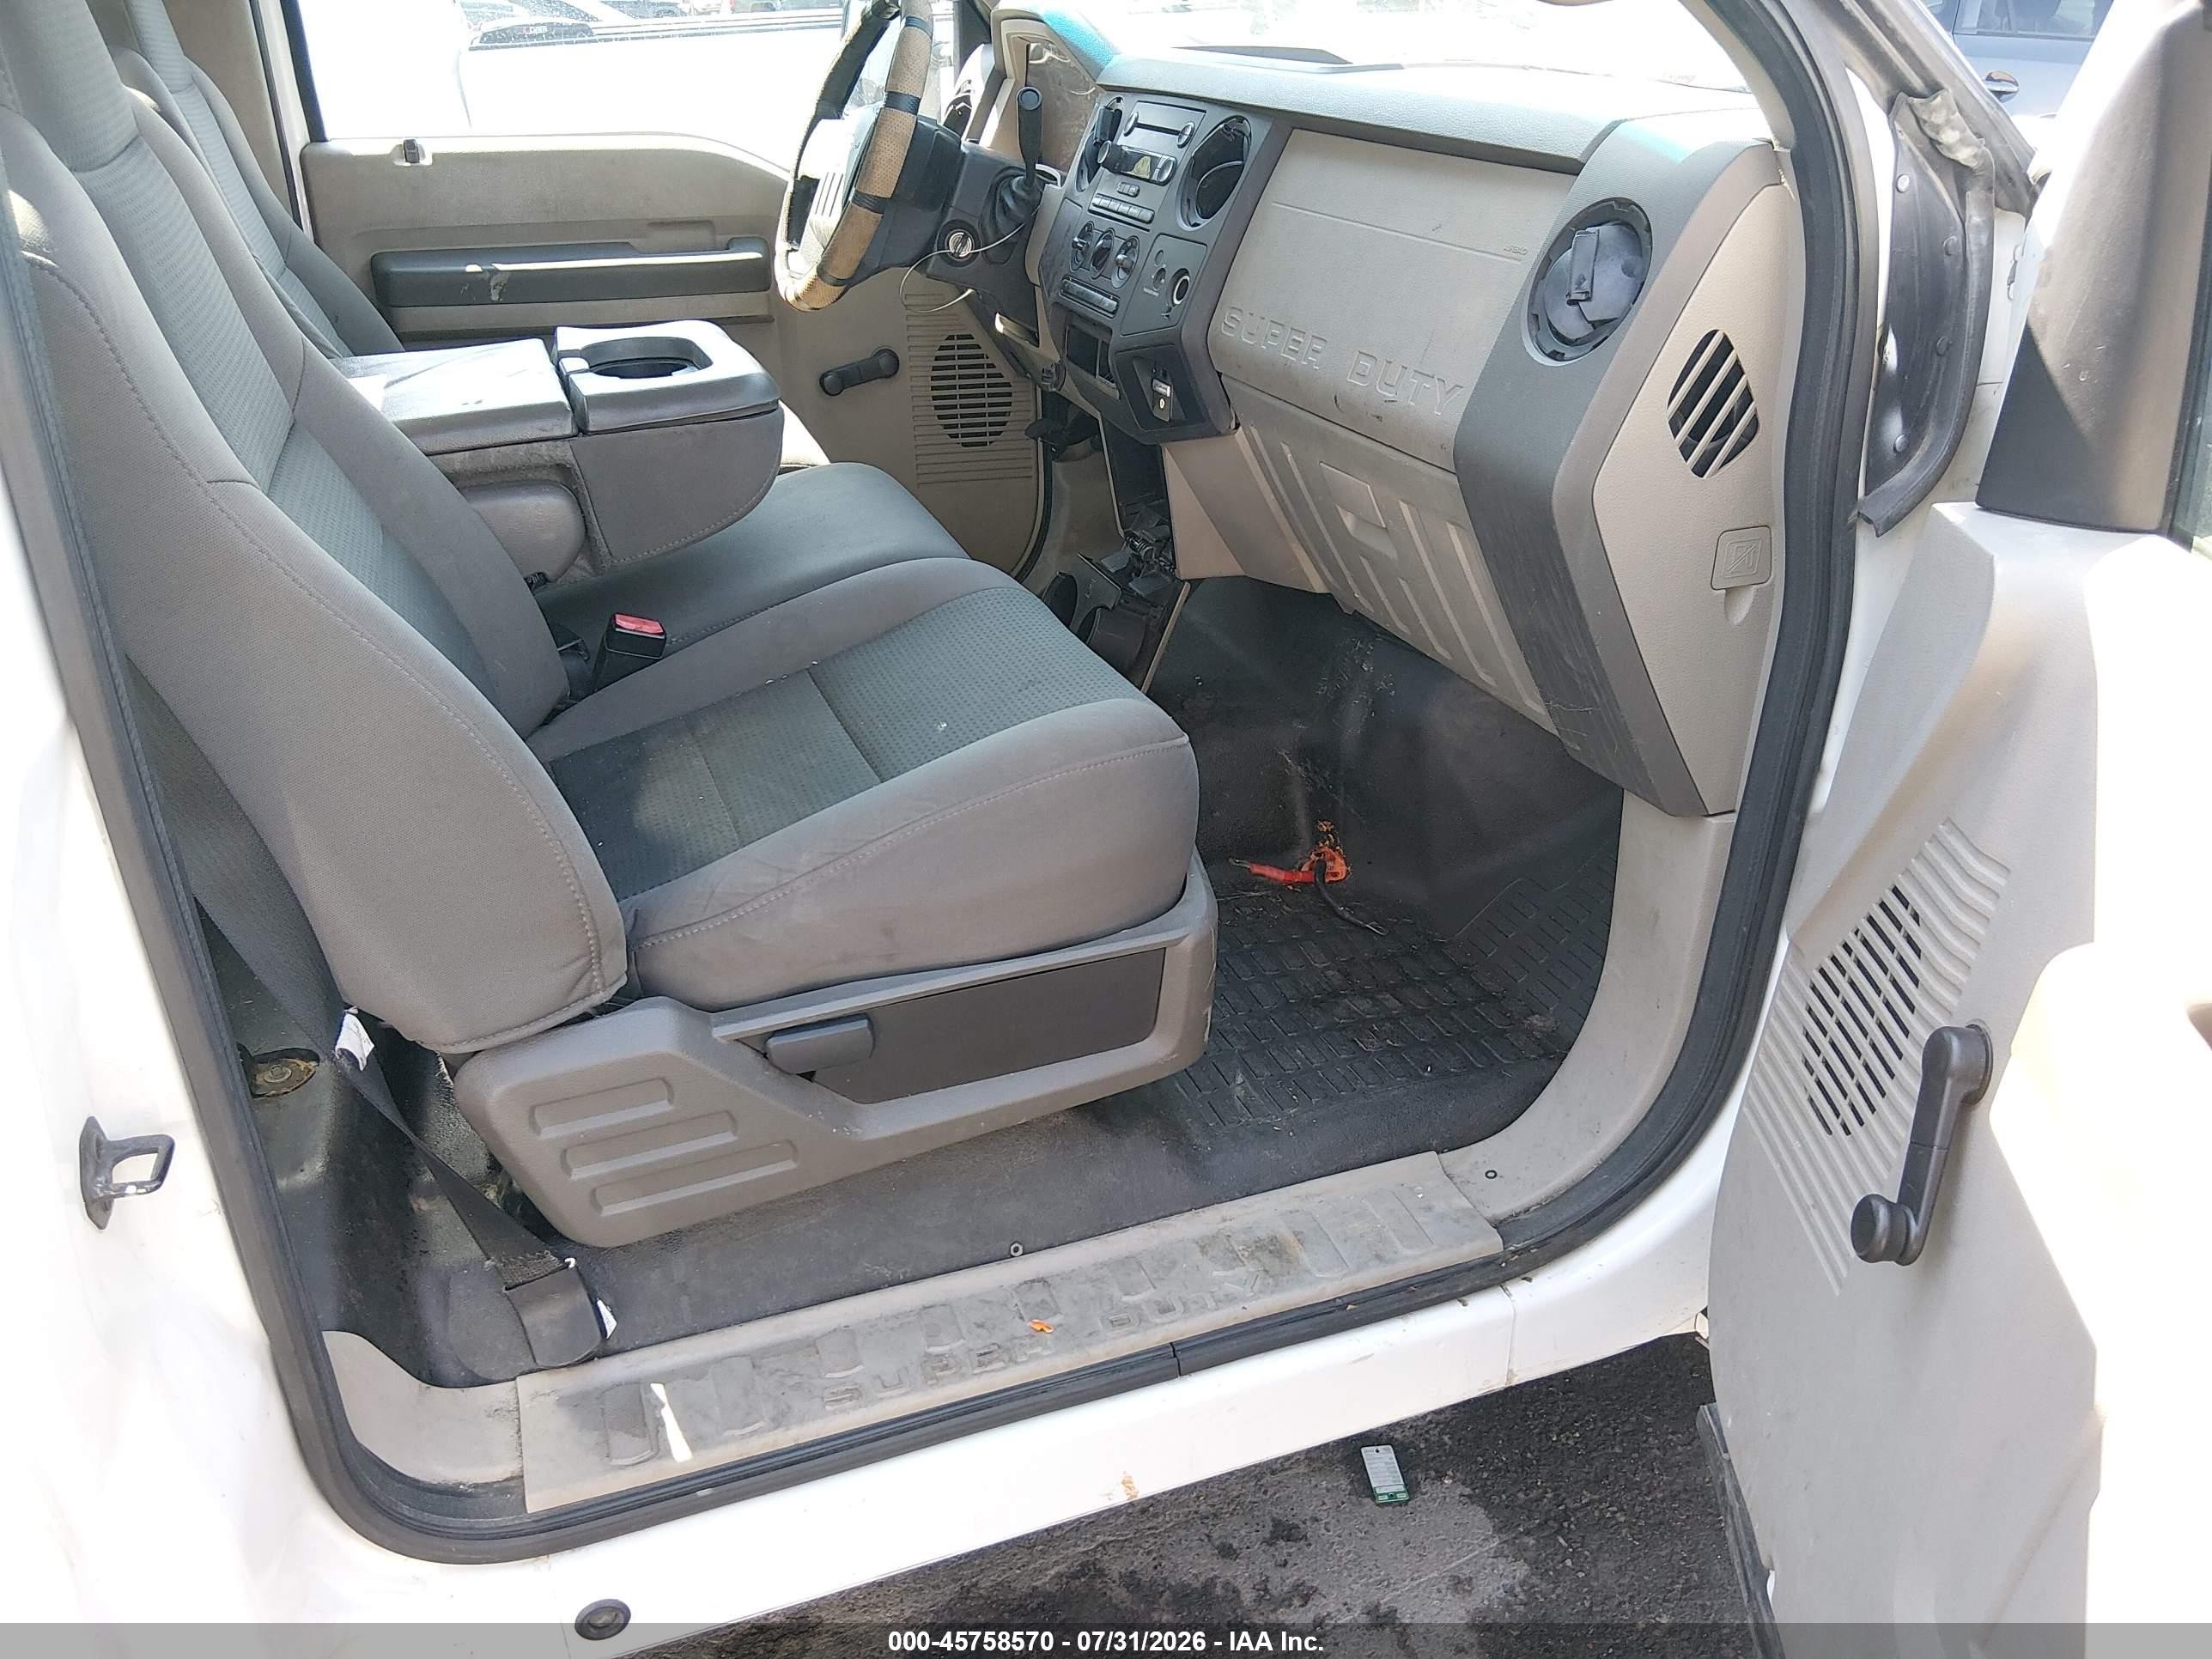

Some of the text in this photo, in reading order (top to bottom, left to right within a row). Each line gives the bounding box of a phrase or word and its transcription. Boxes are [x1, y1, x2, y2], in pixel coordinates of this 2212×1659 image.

[1221, 306, 1464, 416] SUPER DUTY
[822, 1336, 1055, 1412] SUPER
